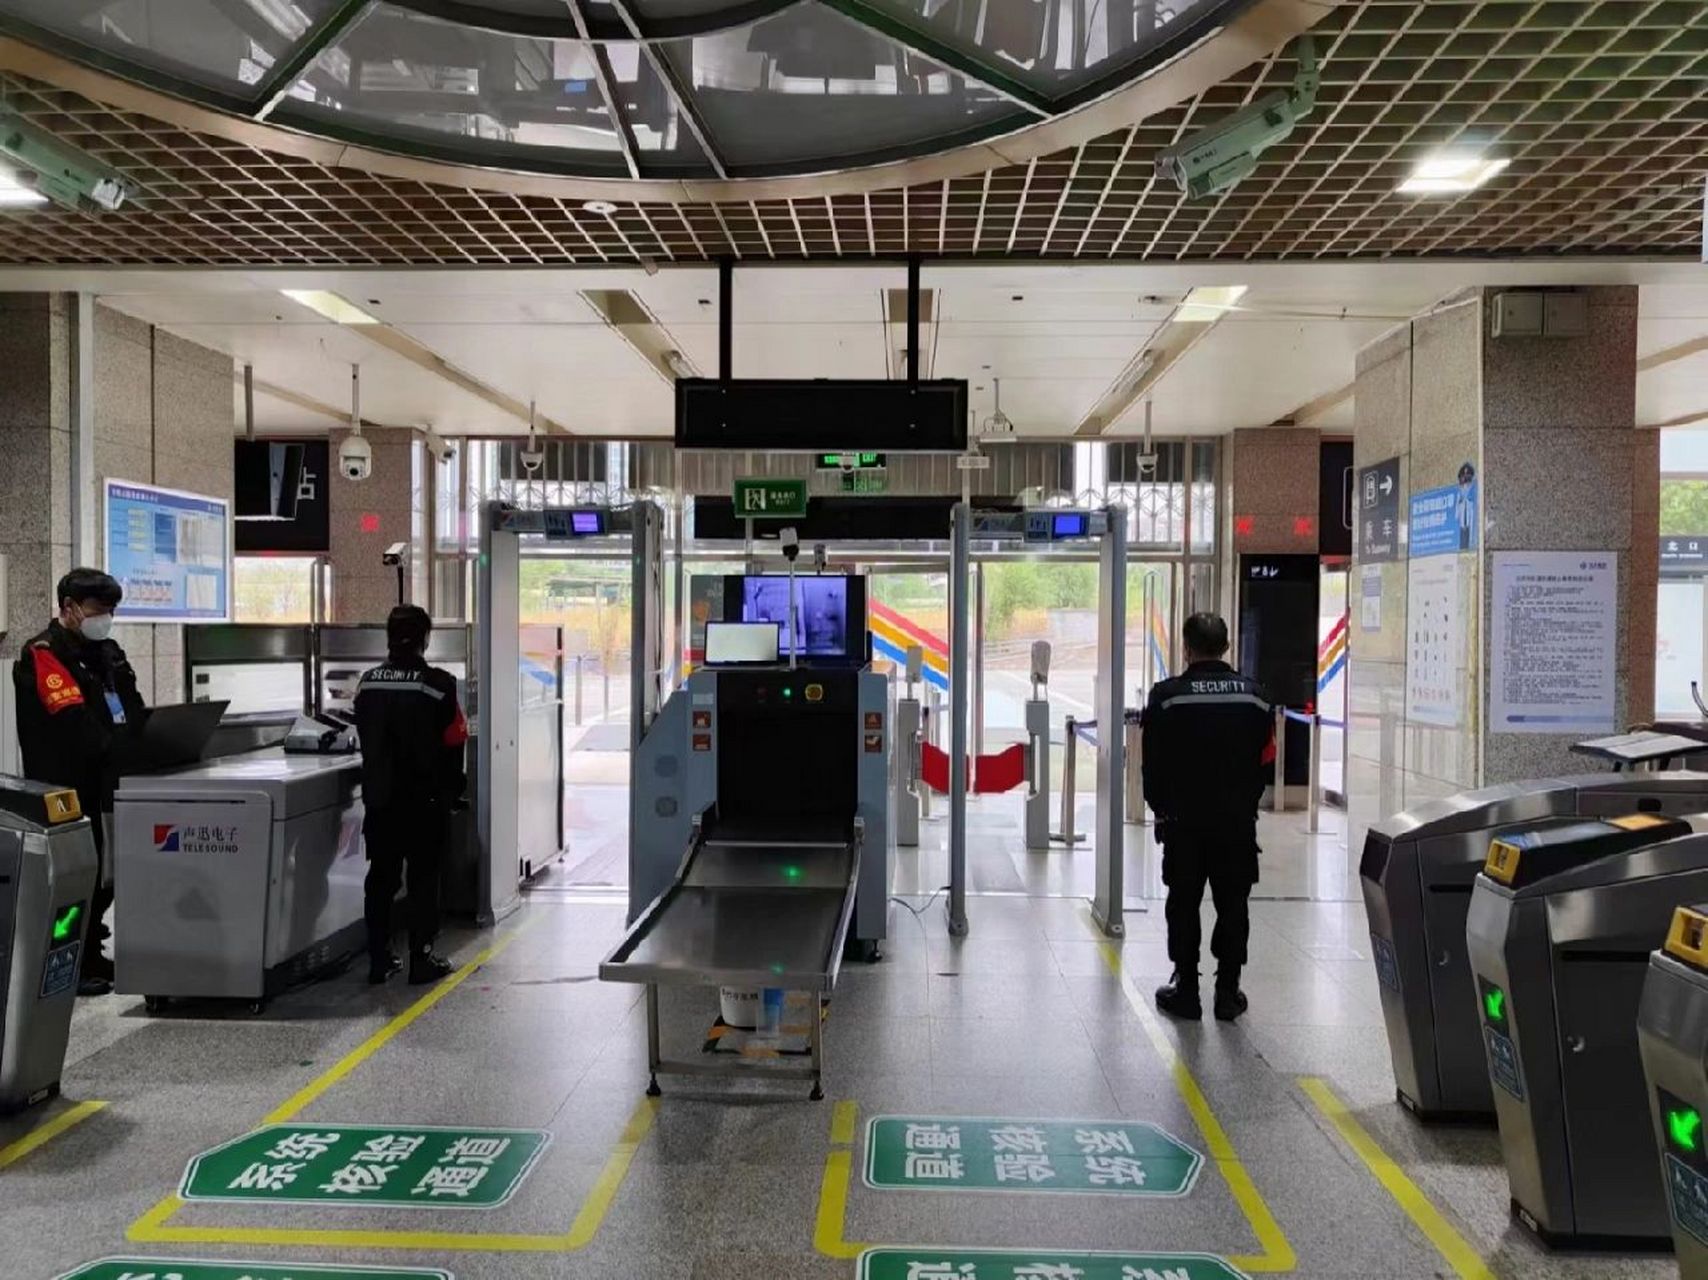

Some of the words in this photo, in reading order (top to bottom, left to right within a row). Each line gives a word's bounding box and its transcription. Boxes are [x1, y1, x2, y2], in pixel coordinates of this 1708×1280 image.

[371, 668, 420, 680] SECURITY
[1191, 681, 1245, 693] SECURITY
[183, 843, 239, 854] TELESOUND
[227, 1132, 341, 1191] 系统
[317, 1133, 426, 1194] 核验
[410, 1136, 512, 1197] 通道
[905, 1123, 966, 1179] 通道
[989, 1125, 1056, 1182] 核验
[1075, 1128, 1147, 1185] 系统
